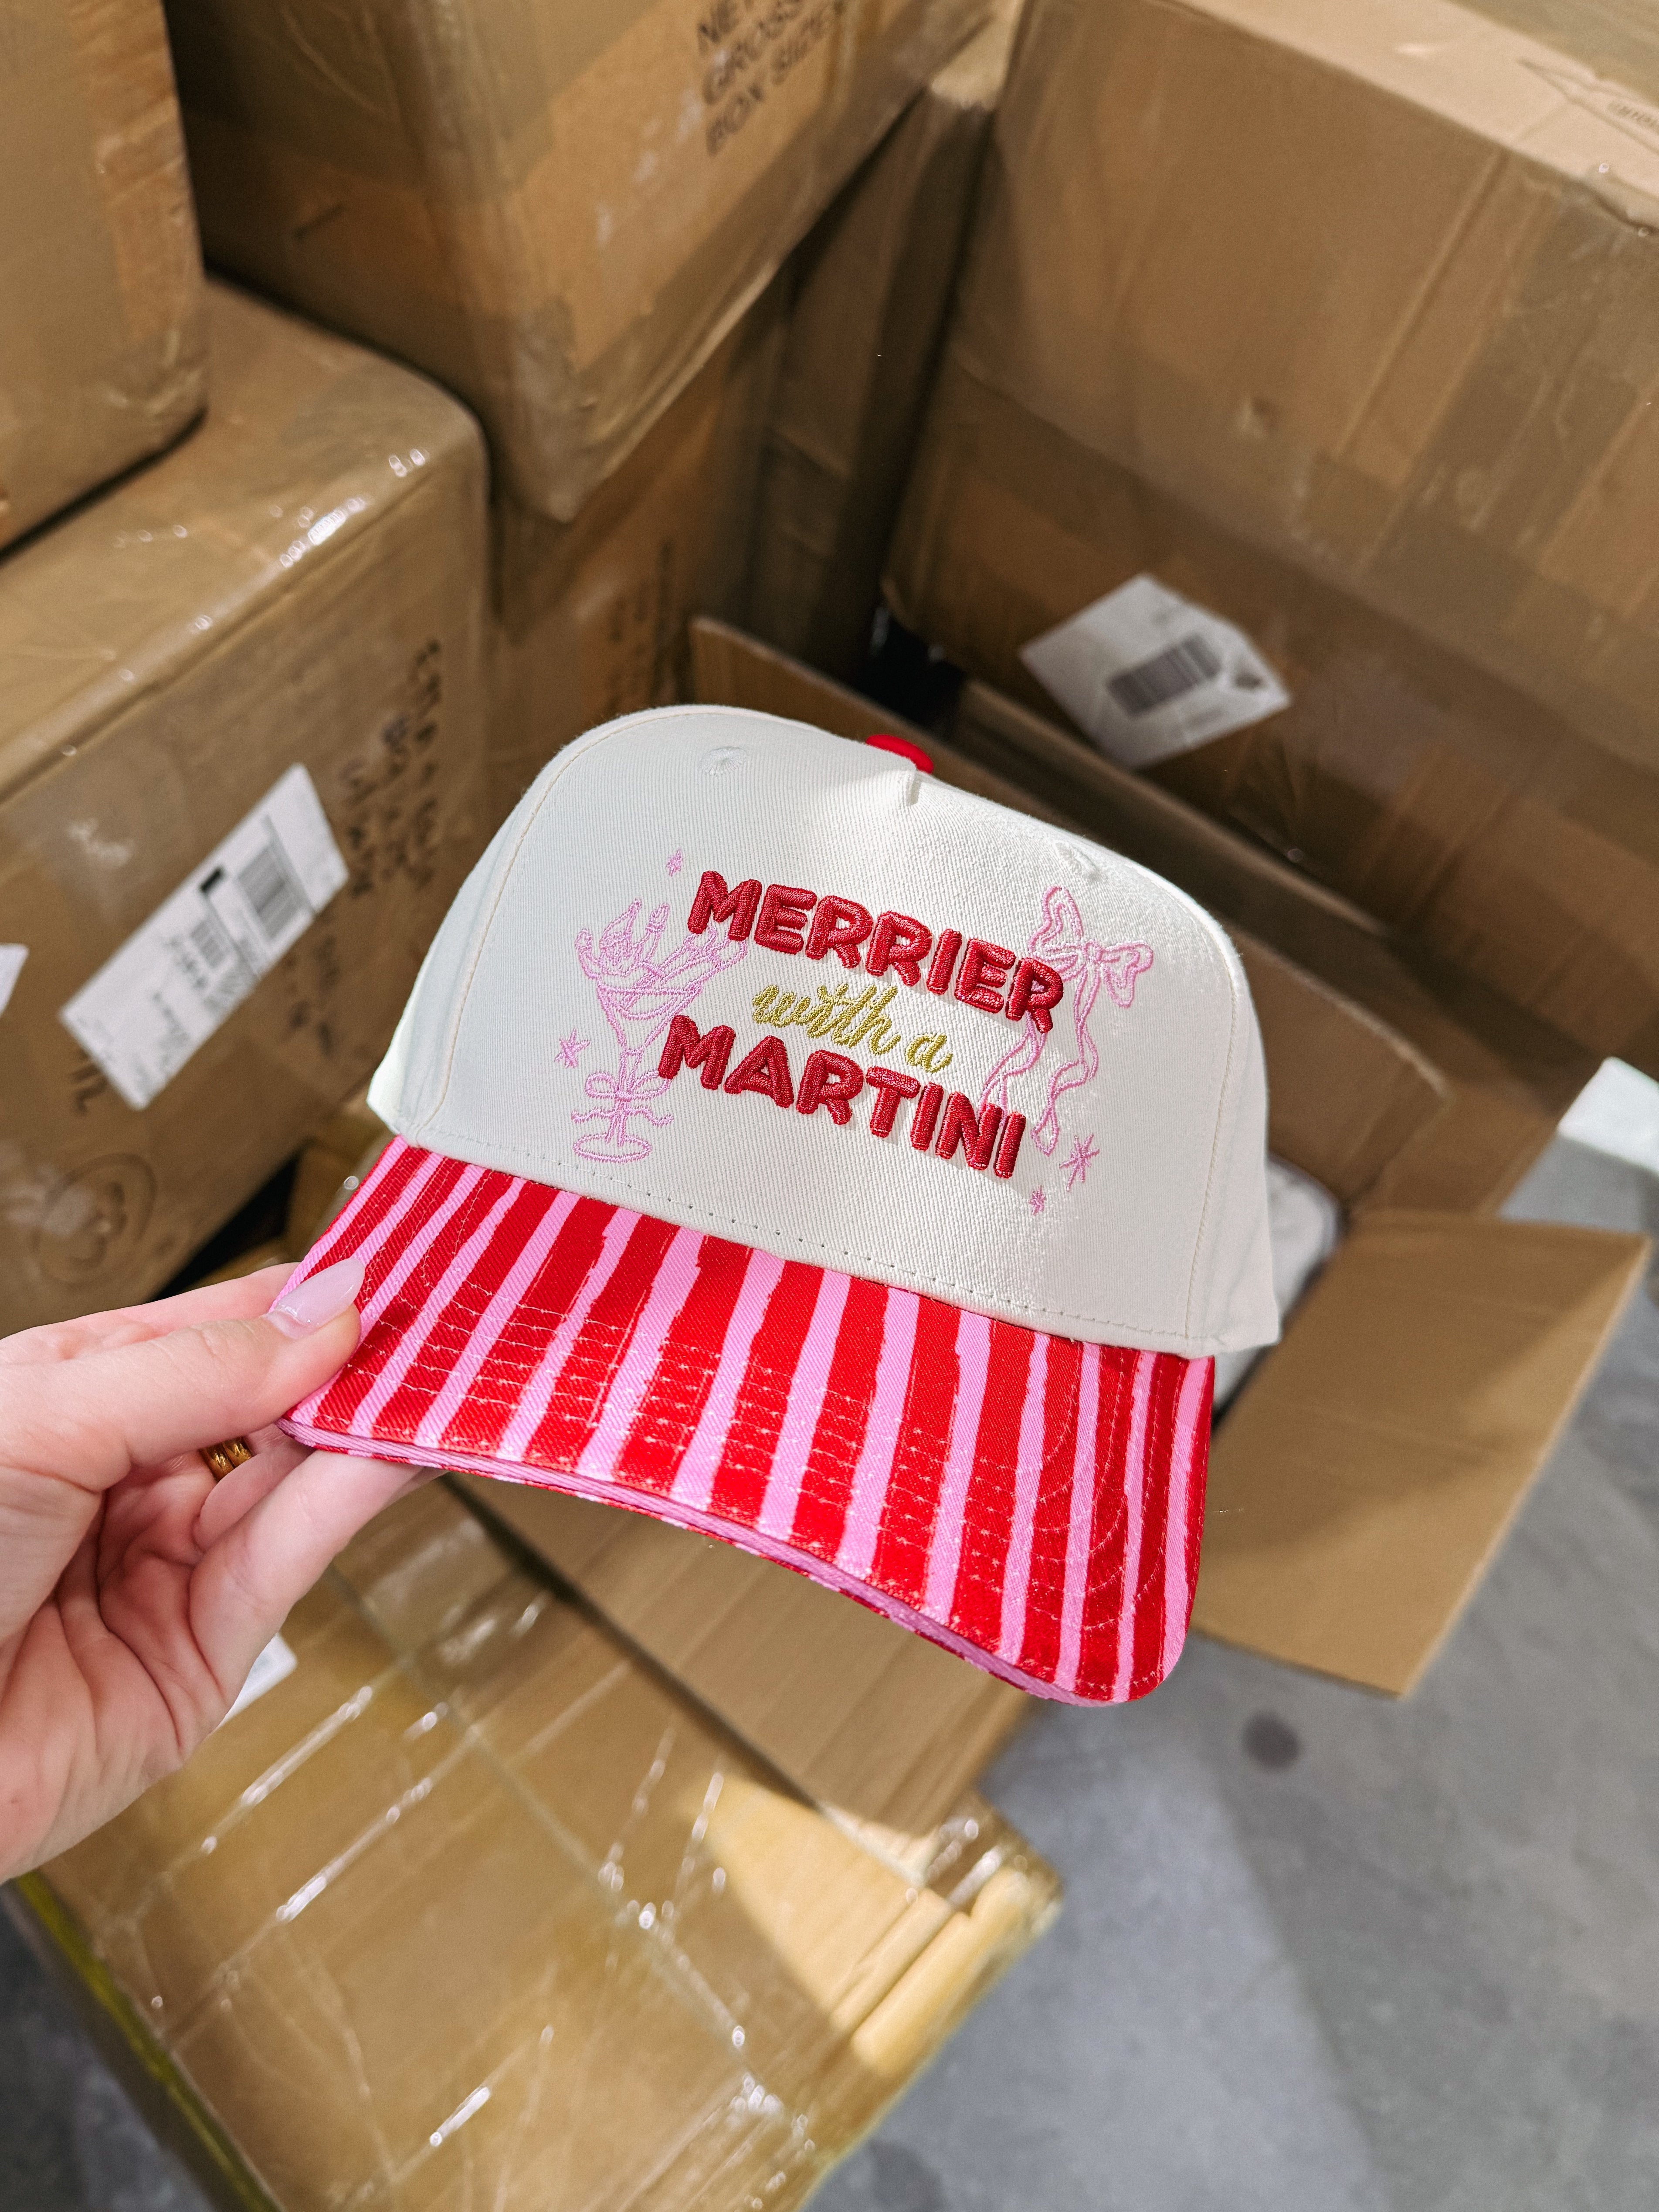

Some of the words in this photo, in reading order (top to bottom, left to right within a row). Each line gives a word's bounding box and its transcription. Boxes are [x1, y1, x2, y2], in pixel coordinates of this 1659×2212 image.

[705, 69, 767, 157] BOX
[687, 870, 1064, 1033] MERRIER
[752, 983, 901, 1055] with
[905, 1032, 954, 1073] a
[657, 1014, 1027, 1179] MARTINI
